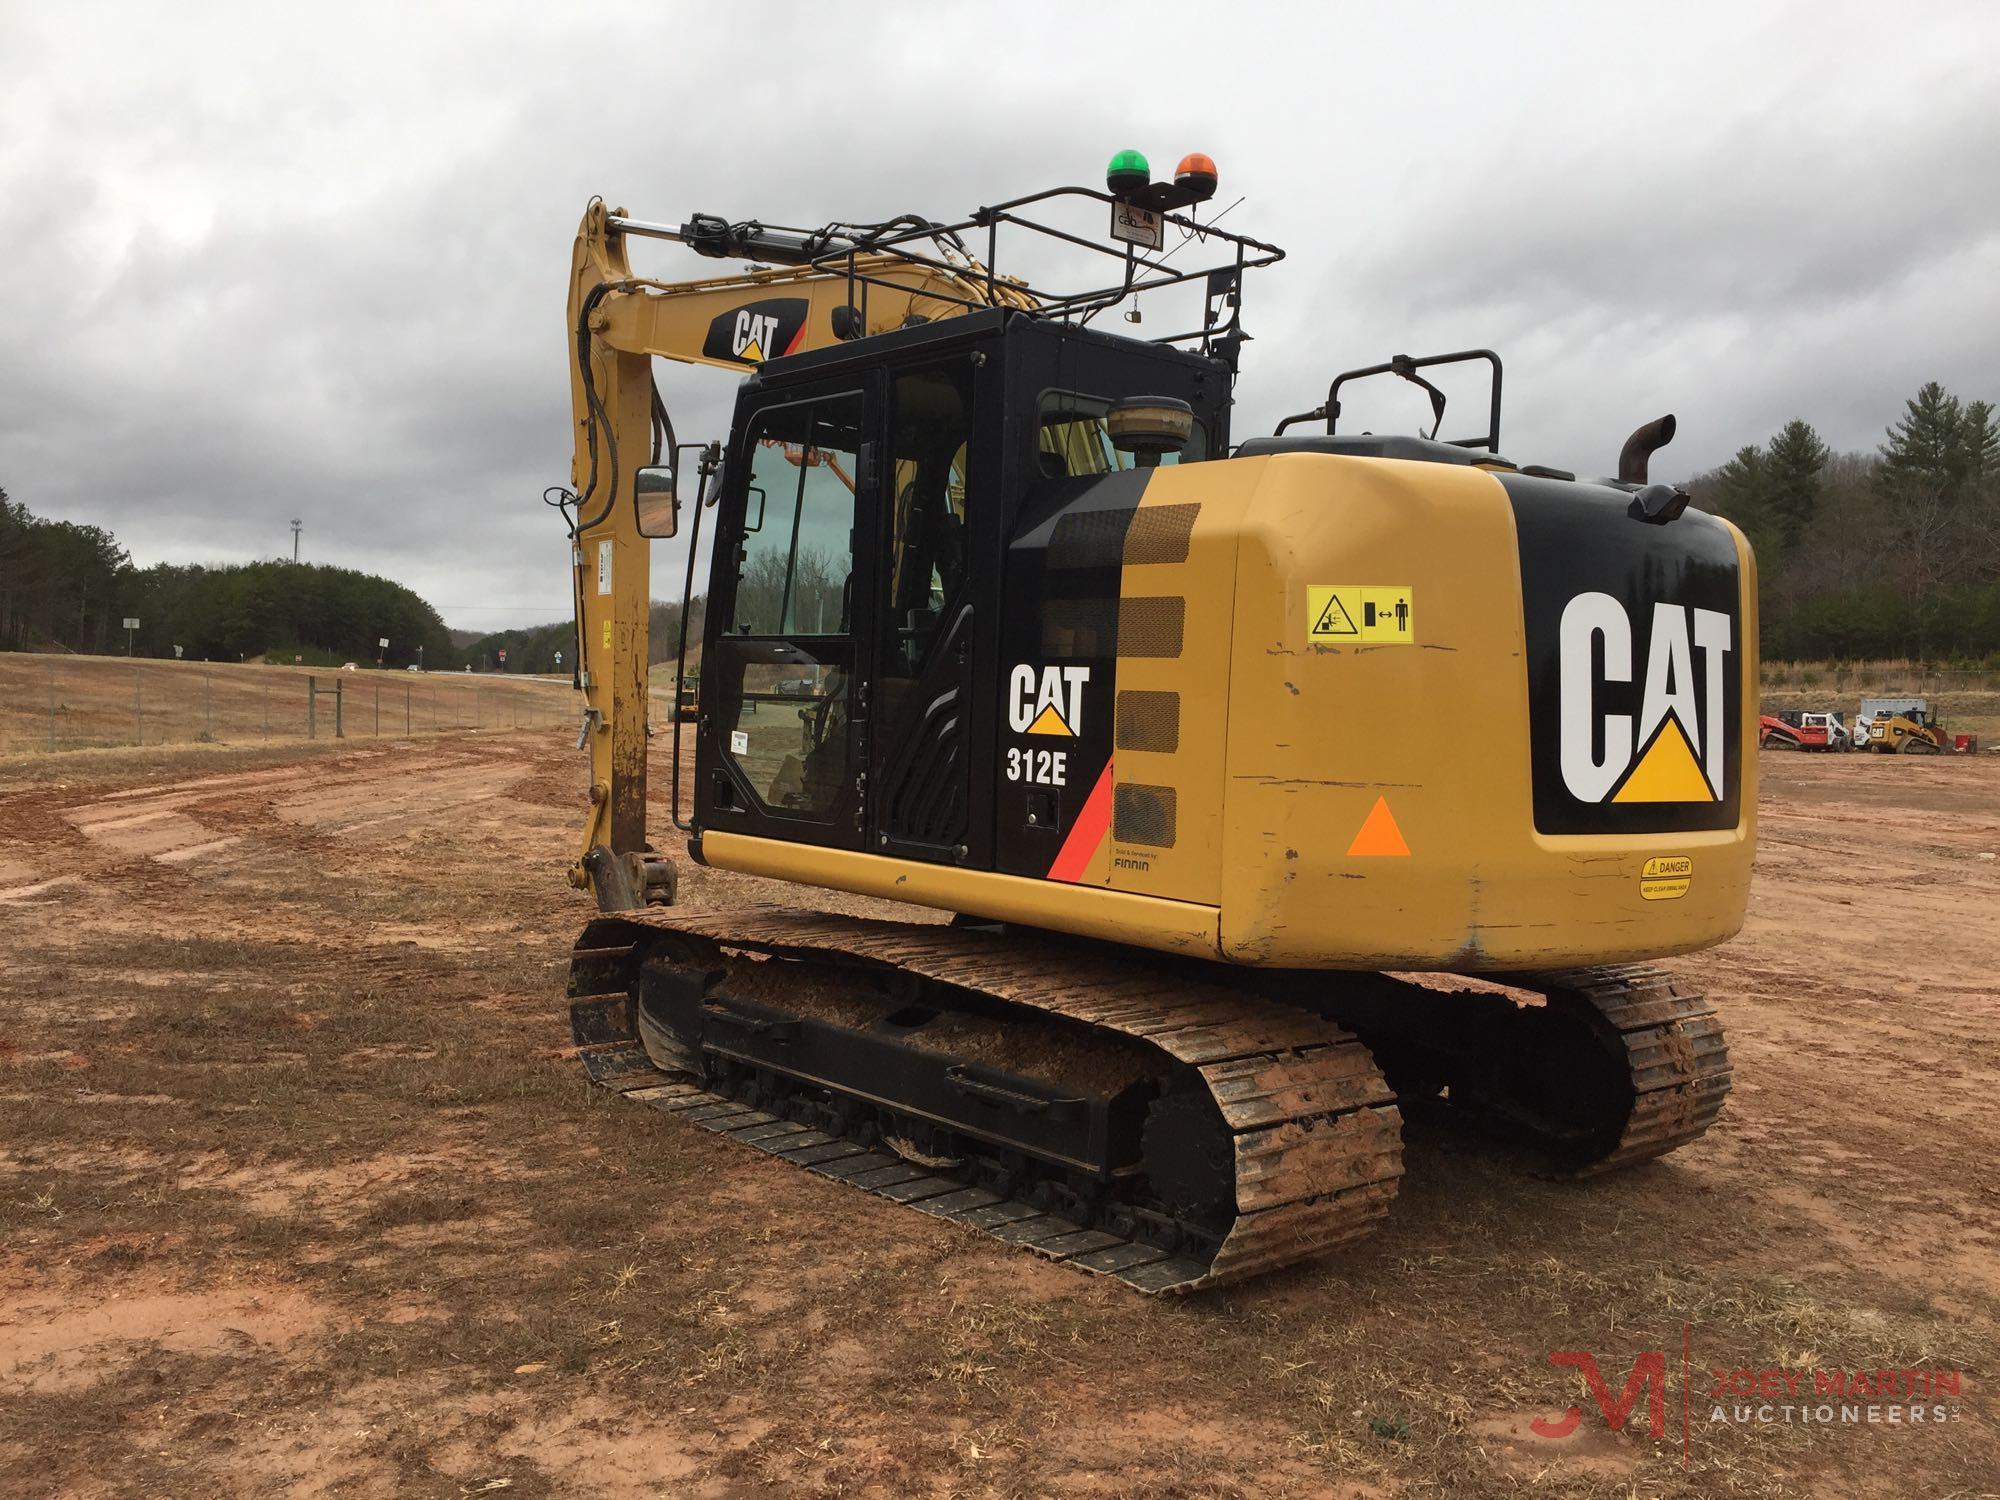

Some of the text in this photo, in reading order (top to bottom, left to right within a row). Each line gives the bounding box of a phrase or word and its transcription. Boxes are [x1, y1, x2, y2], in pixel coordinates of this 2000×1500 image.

[732, 309, 779, 361] CAT
[1008, 663, 1090, 737] CAT
[1559, 591, 1732, 803] CAT
[1006, 748, 1067, 786] 312E
[1659, 861, 1690, 873] DANGER
